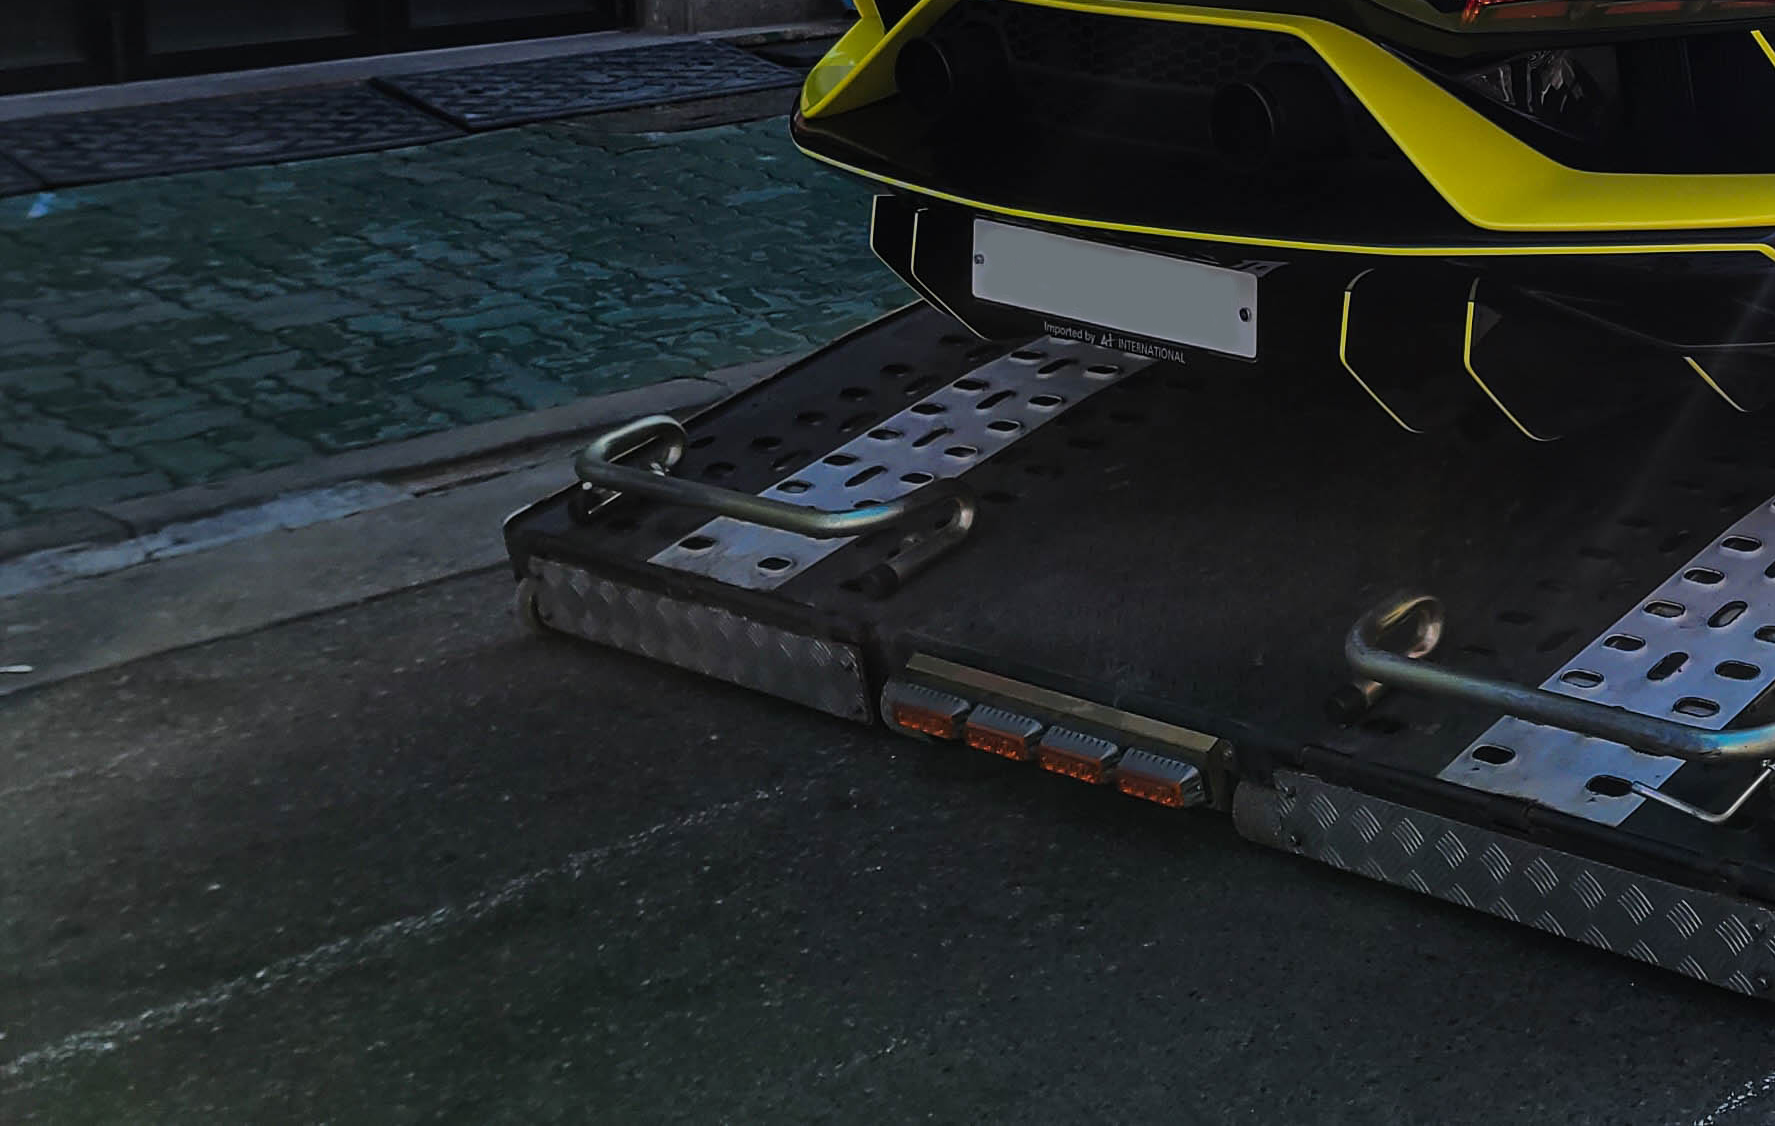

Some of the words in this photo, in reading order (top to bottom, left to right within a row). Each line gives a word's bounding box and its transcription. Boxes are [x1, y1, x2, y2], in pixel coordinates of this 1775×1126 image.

[1044, 321, 1083, 339] Imported
[1084, 329, 1096, 345] by
[1118, 338, 1186, 364] INTERNATIONAL
